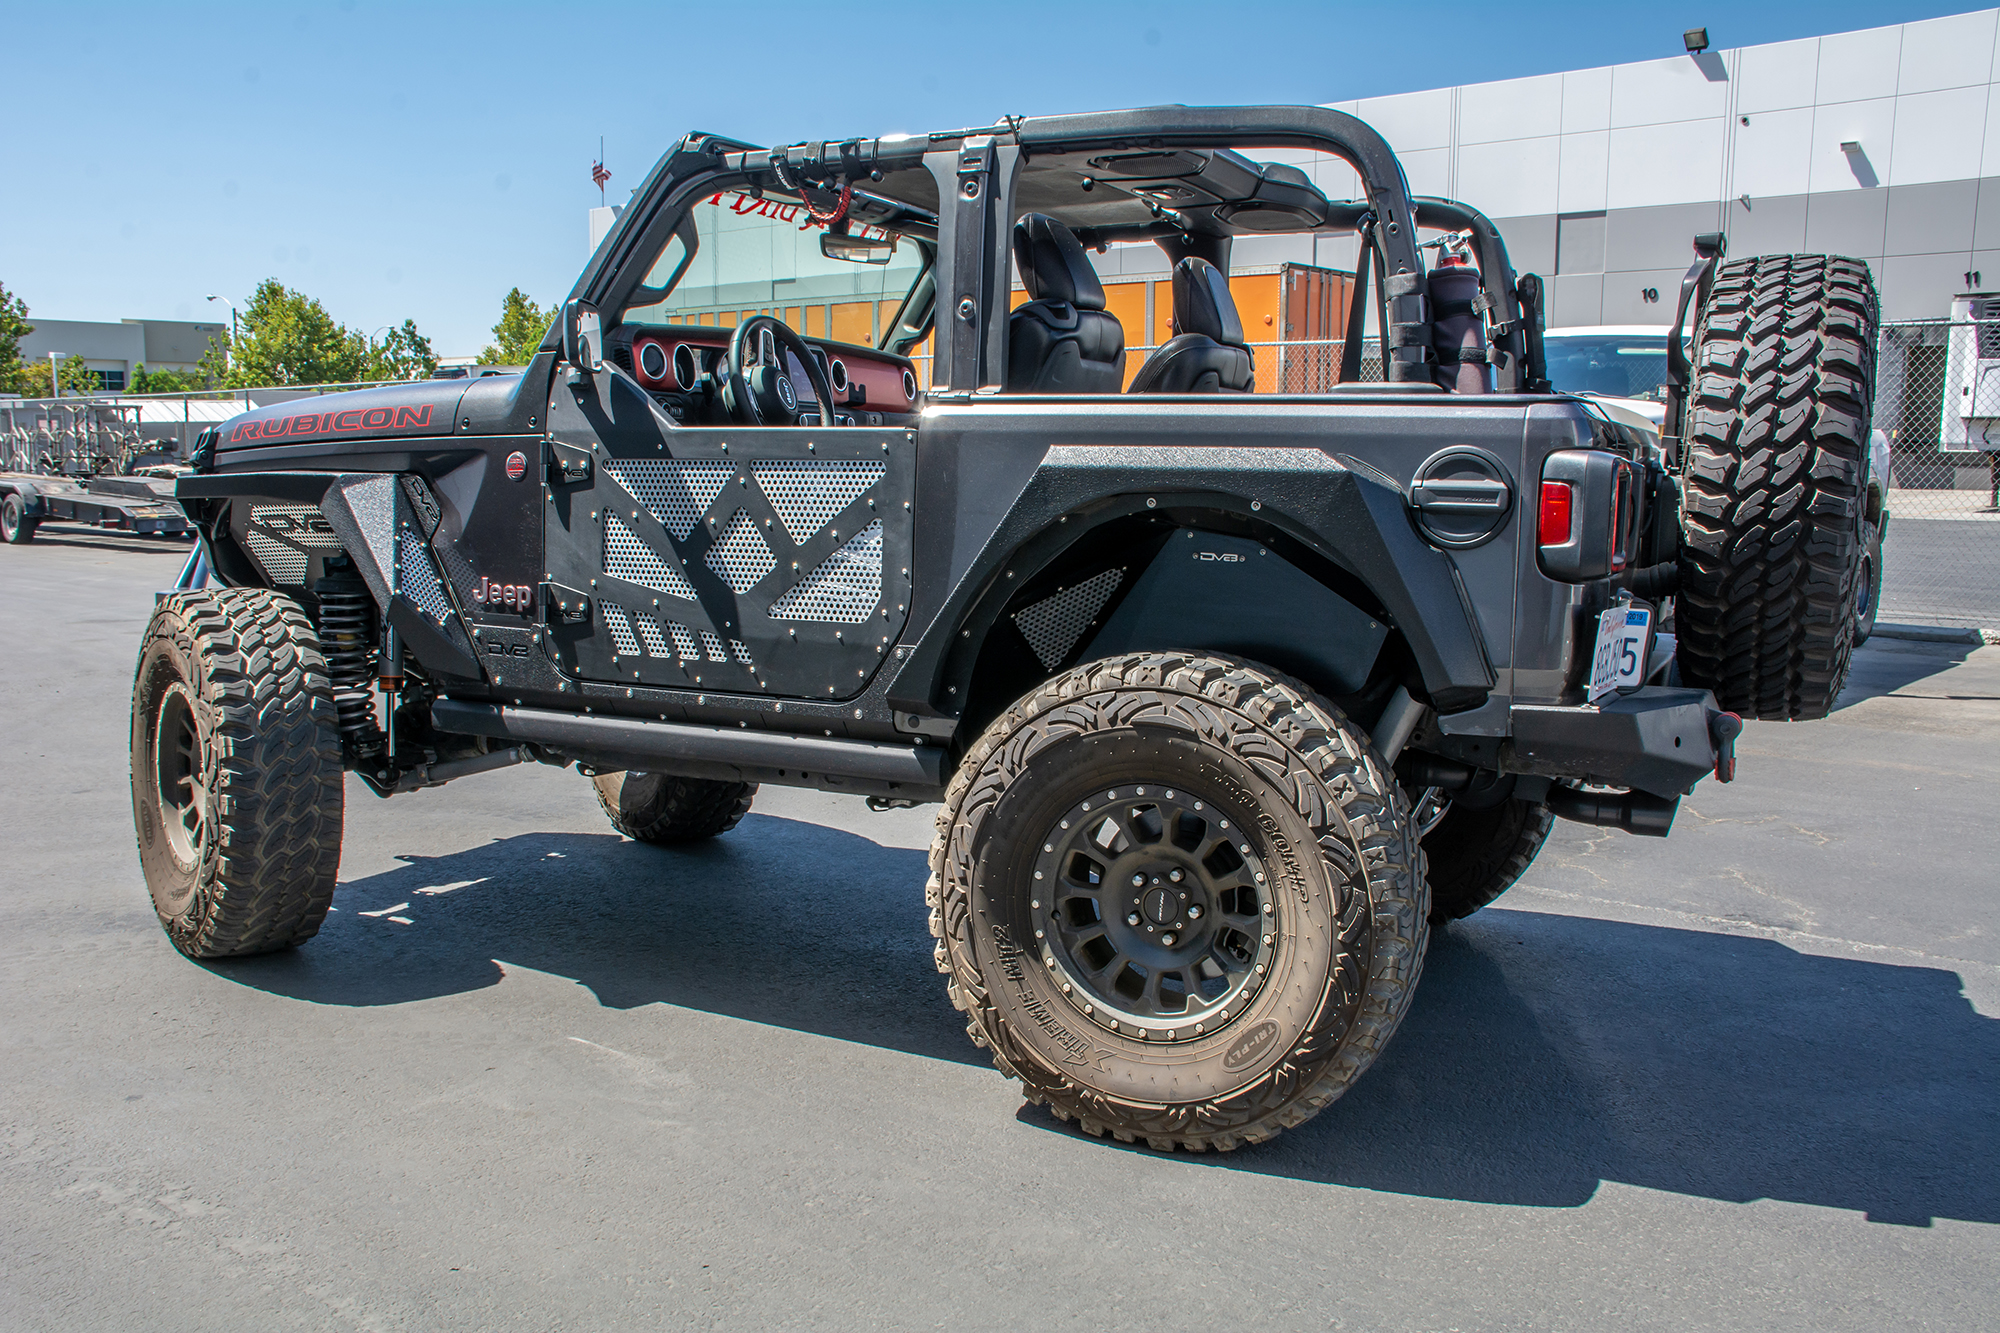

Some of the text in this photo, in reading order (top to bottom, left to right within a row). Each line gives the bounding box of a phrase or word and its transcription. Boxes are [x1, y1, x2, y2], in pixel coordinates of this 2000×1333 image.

[1964, 271, 1980, 284] 11
[1641, 287, 1657, 301] 10
[231, 404, 434, 442] RUBICON
[1200, 551, 1239, 563] DV8
[472, 576, 532, 612] Jeep
[1628, 612, 1643, 620] 2019
[1227, 1024, 1277, 1067] TRI-PLY
